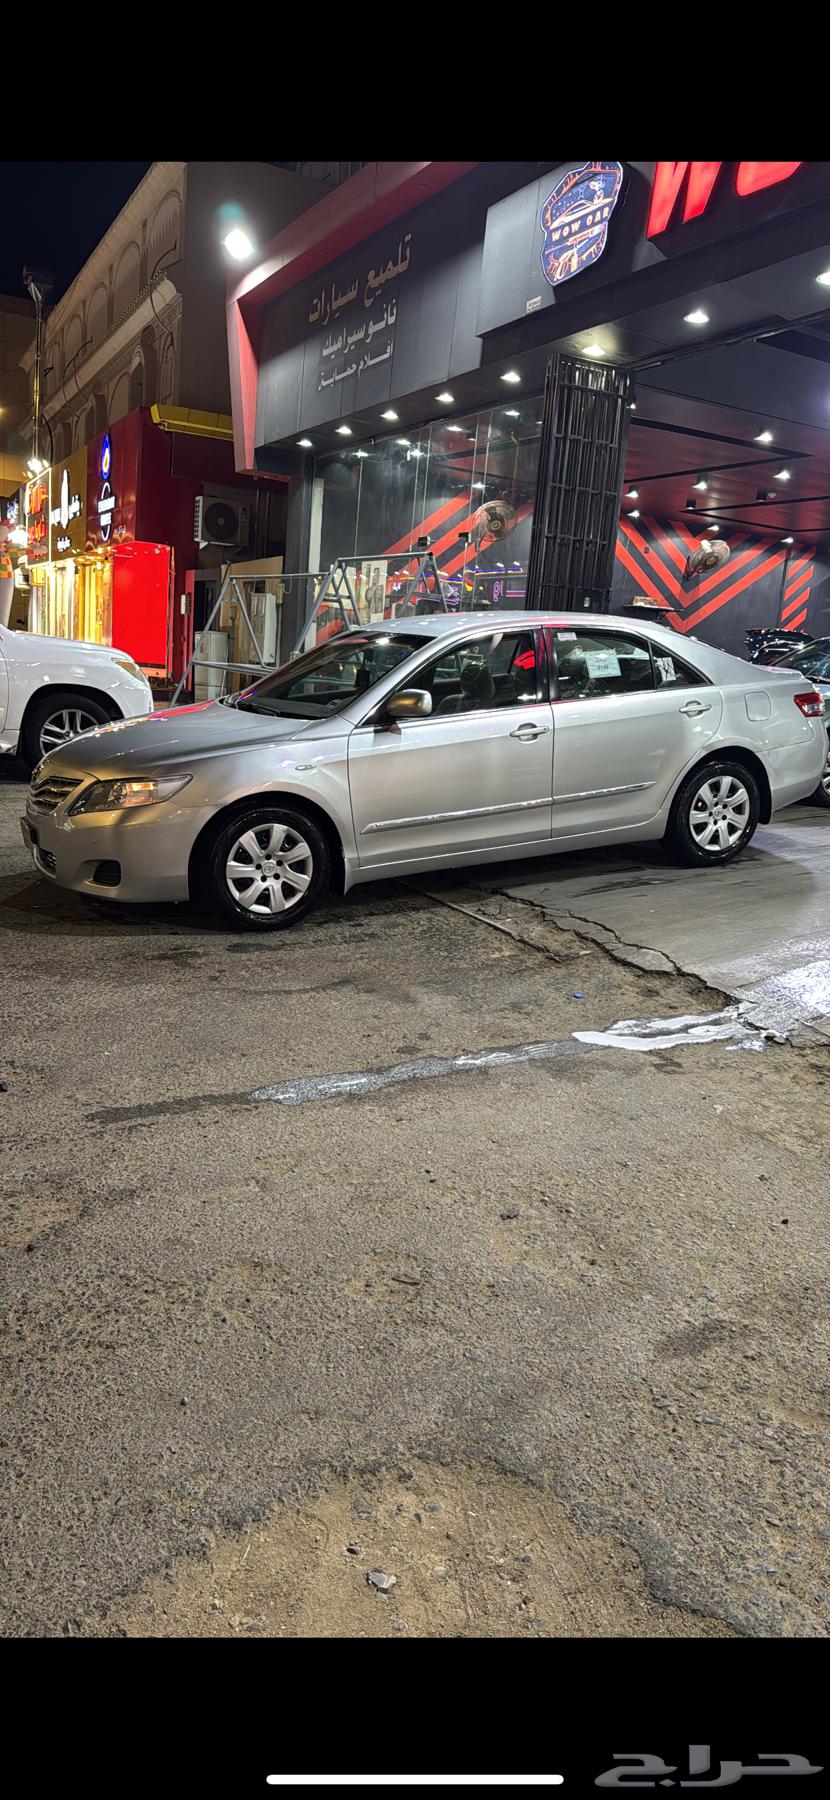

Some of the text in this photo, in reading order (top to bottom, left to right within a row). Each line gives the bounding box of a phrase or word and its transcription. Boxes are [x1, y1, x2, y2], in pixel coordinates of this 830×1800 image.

[551, 220, 581, 241] WOW
[309, 233, 412, 325] تلميع سيارات
[323, 299, 396, 359] نانو سيراميك
